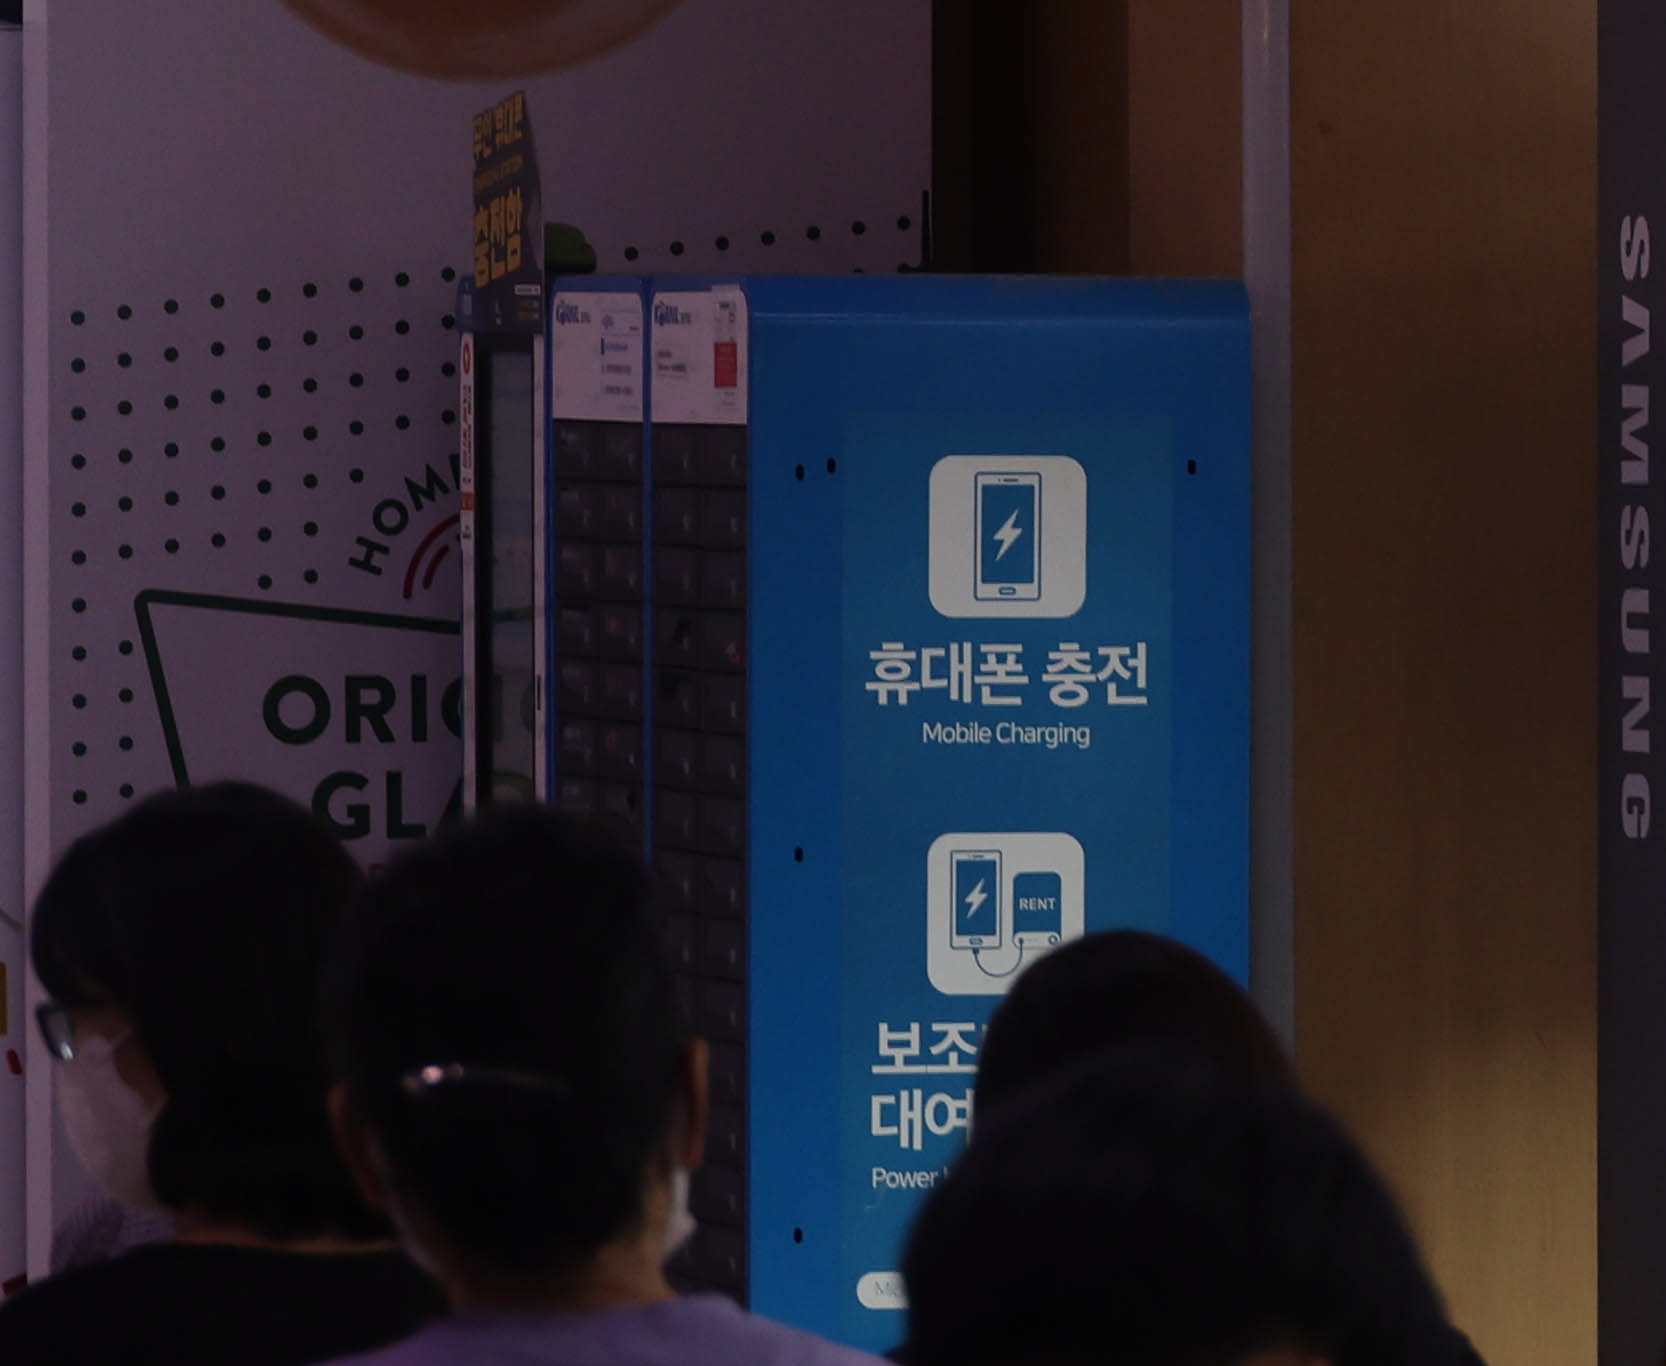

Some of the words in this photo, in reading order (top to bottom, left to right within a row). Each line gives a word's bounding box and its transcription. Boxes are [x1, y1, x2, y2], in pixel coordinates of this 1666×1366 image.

[1620, 214, 1651, 841] SAMSUNG
[865, 641, 1030, 706] 휴대폰
[1041, 641, 1149, 708] 충전
[922, 722, 993, 744] Mobile
[995, 722, 1091, 750] Charging
[1018, 897, 1057, 912] RENT
[872, 1166, 938, 1189] Power
